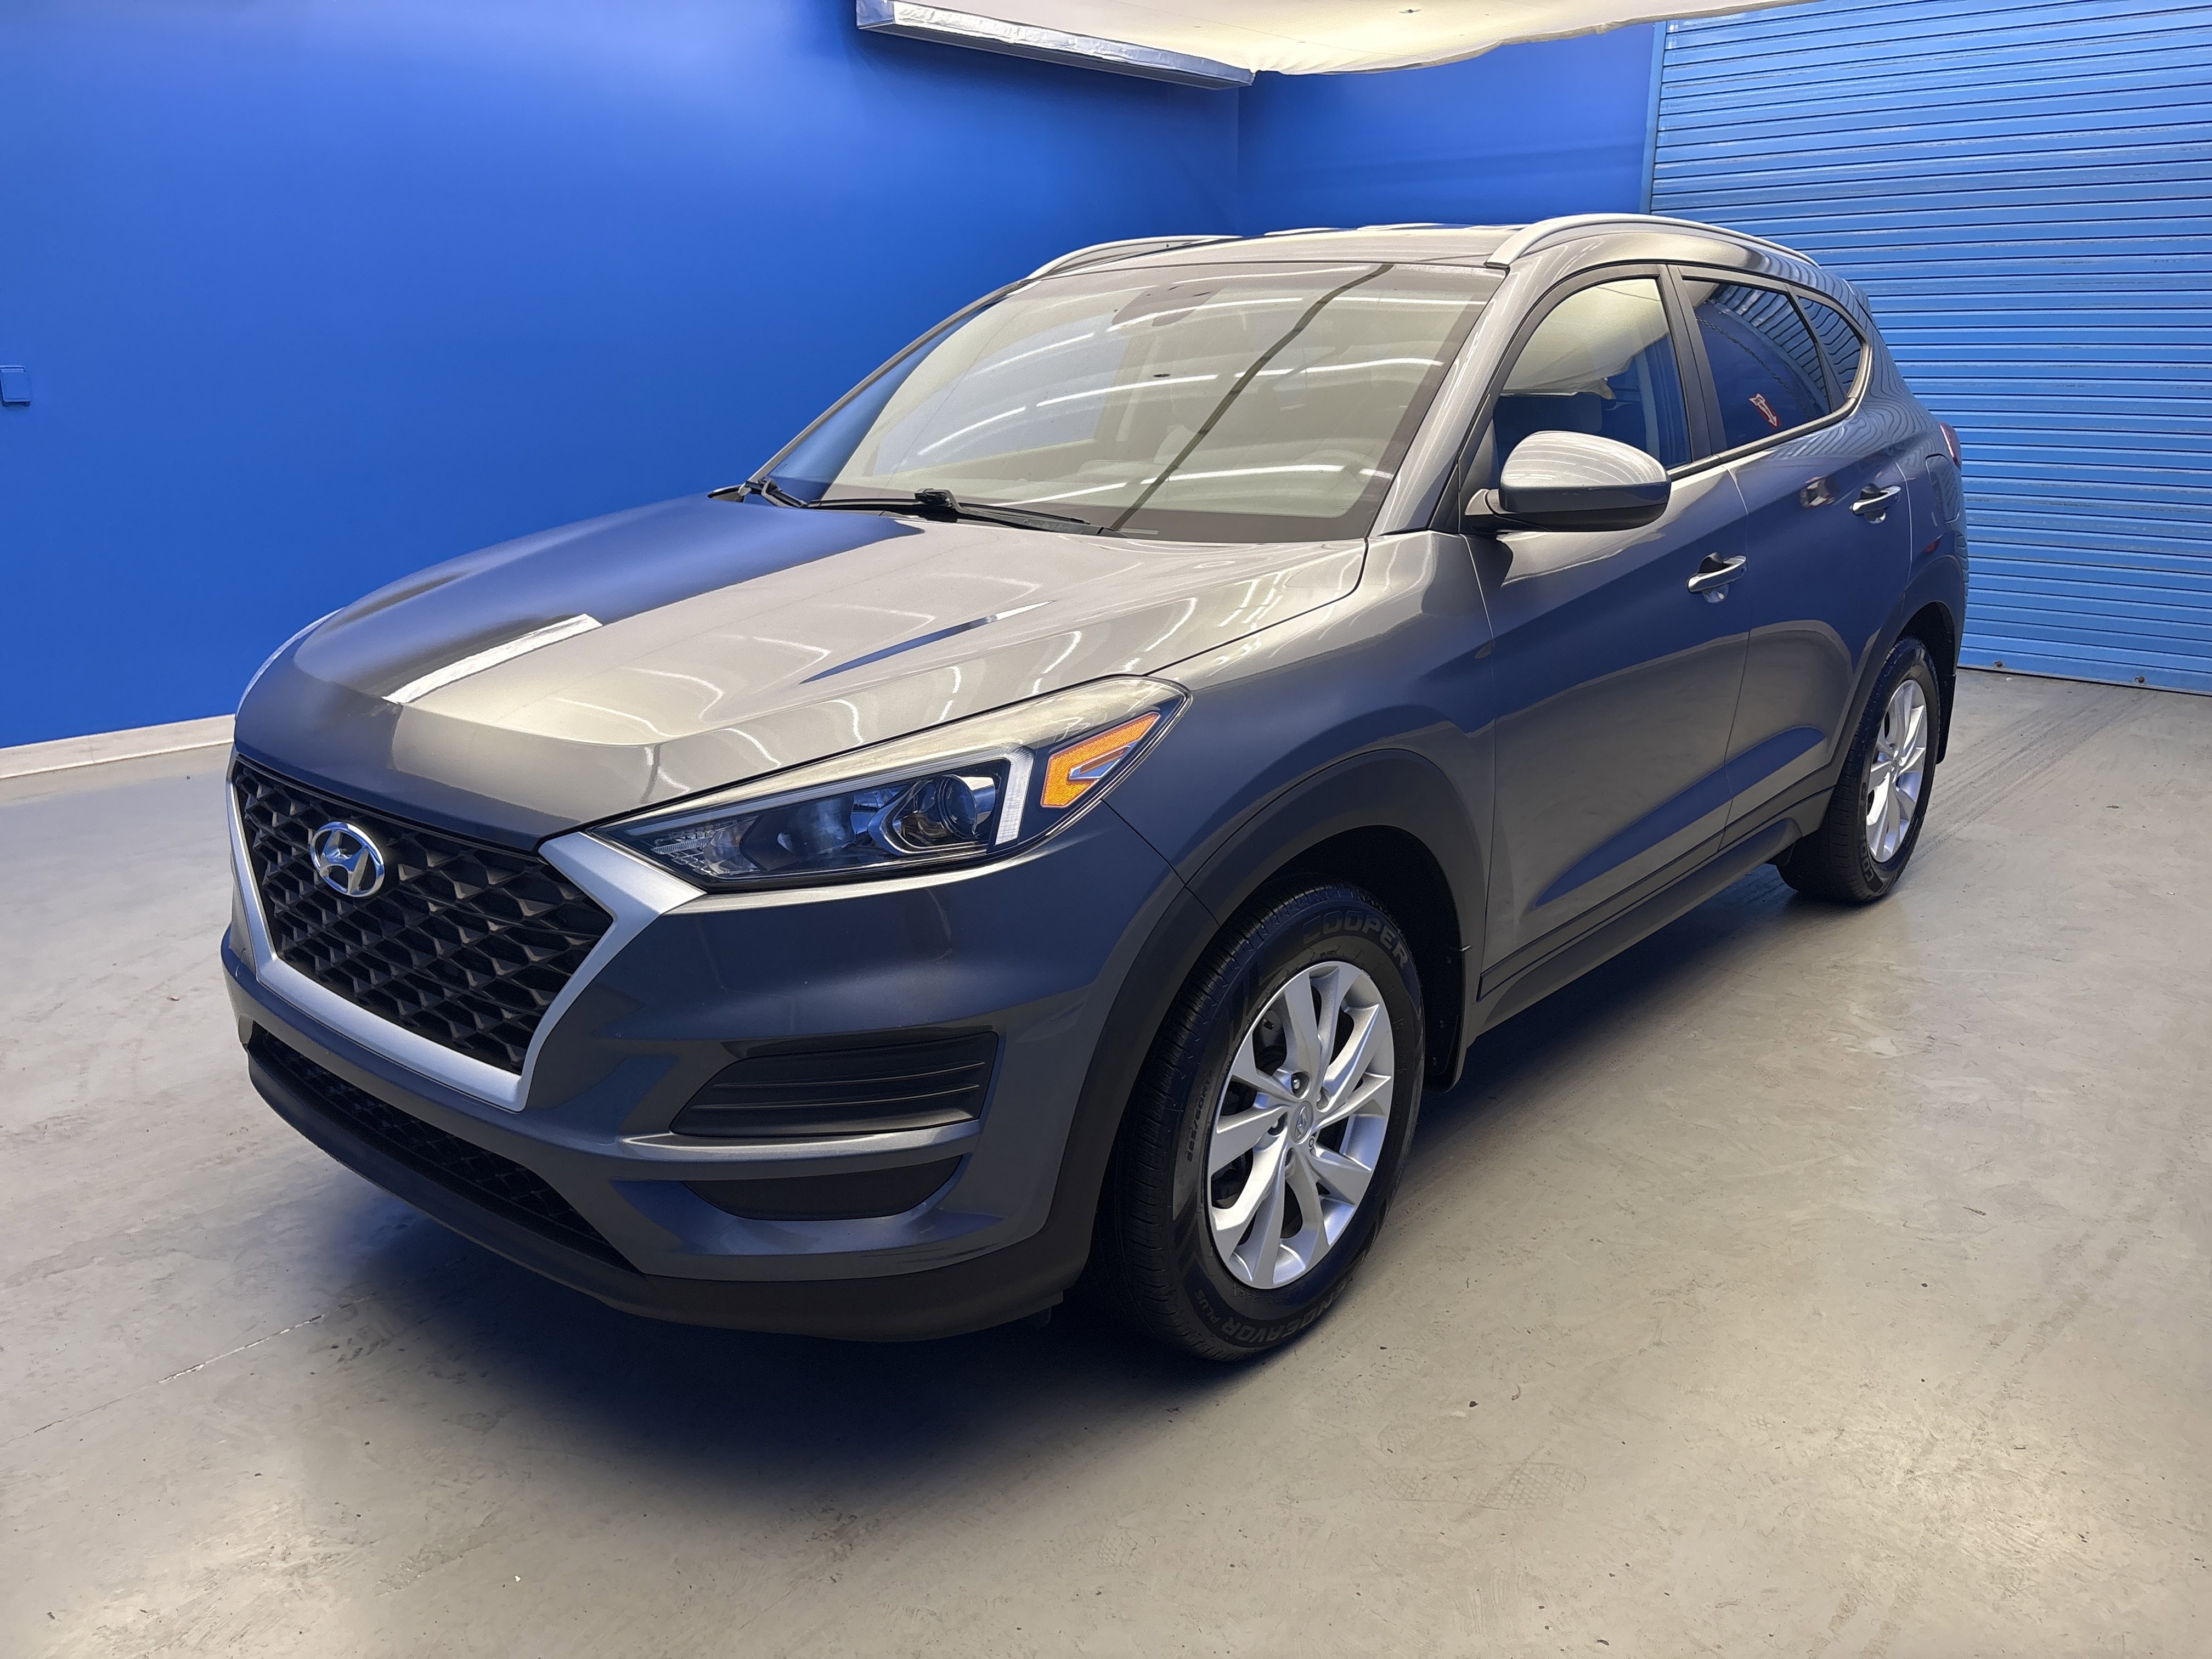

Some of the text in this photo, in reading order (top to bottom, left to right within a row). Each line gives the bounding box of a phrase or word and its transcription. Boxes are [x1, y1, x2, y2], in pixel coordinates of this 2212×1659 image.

[1303, 910, 1408, 969] COOPER
[1195, 1278, 1347, 1343] ENDEAVOR PLUS
